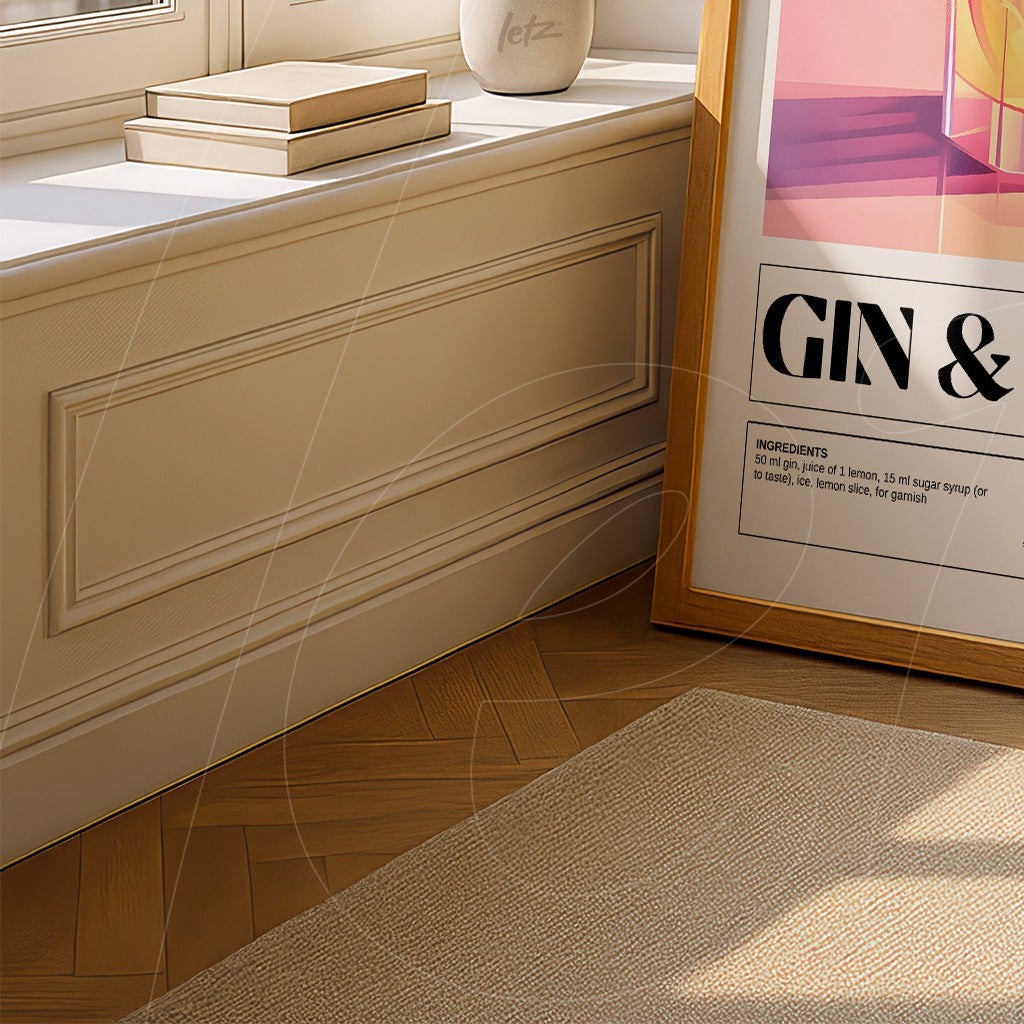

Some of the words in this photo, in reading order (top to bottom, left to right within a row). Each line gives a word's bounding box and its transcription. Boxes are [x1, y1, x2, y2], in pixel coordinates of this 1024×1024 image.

[497, 11, 562, 53] letz
[762, 293, 915, 391] GIN
[938, 312, 1014, 402] &
[756, 439, 828, 458] INGREDIENTS
[754, 453, 767, 465] 50
[769, 456, 781, 467] ml
[782, 457, 800, 471] gin,
[801, 460, 824, 474] juice
[827, 464, 837, 475] of
[839, 466, 844, 476] 1
[848, 466, 880, 483] lemon,
[884, 472, 895, 483] 15
[898, 475, 910, 486] ml
[912, 478, 940, 491] sugar
[943, 482, 970, 497] syrup
[973, 484, 988, 498] (or
[754, 469, 762, 479] to
[765, 471, 793, 486] taste),
[796, 476, 813, 487] ice,
[816, 477, 845, 492] lemon
[848, 483, 871, 497] slice,
[875, 486, 889, 498] for
[891, 490, 927, 504] garnish
